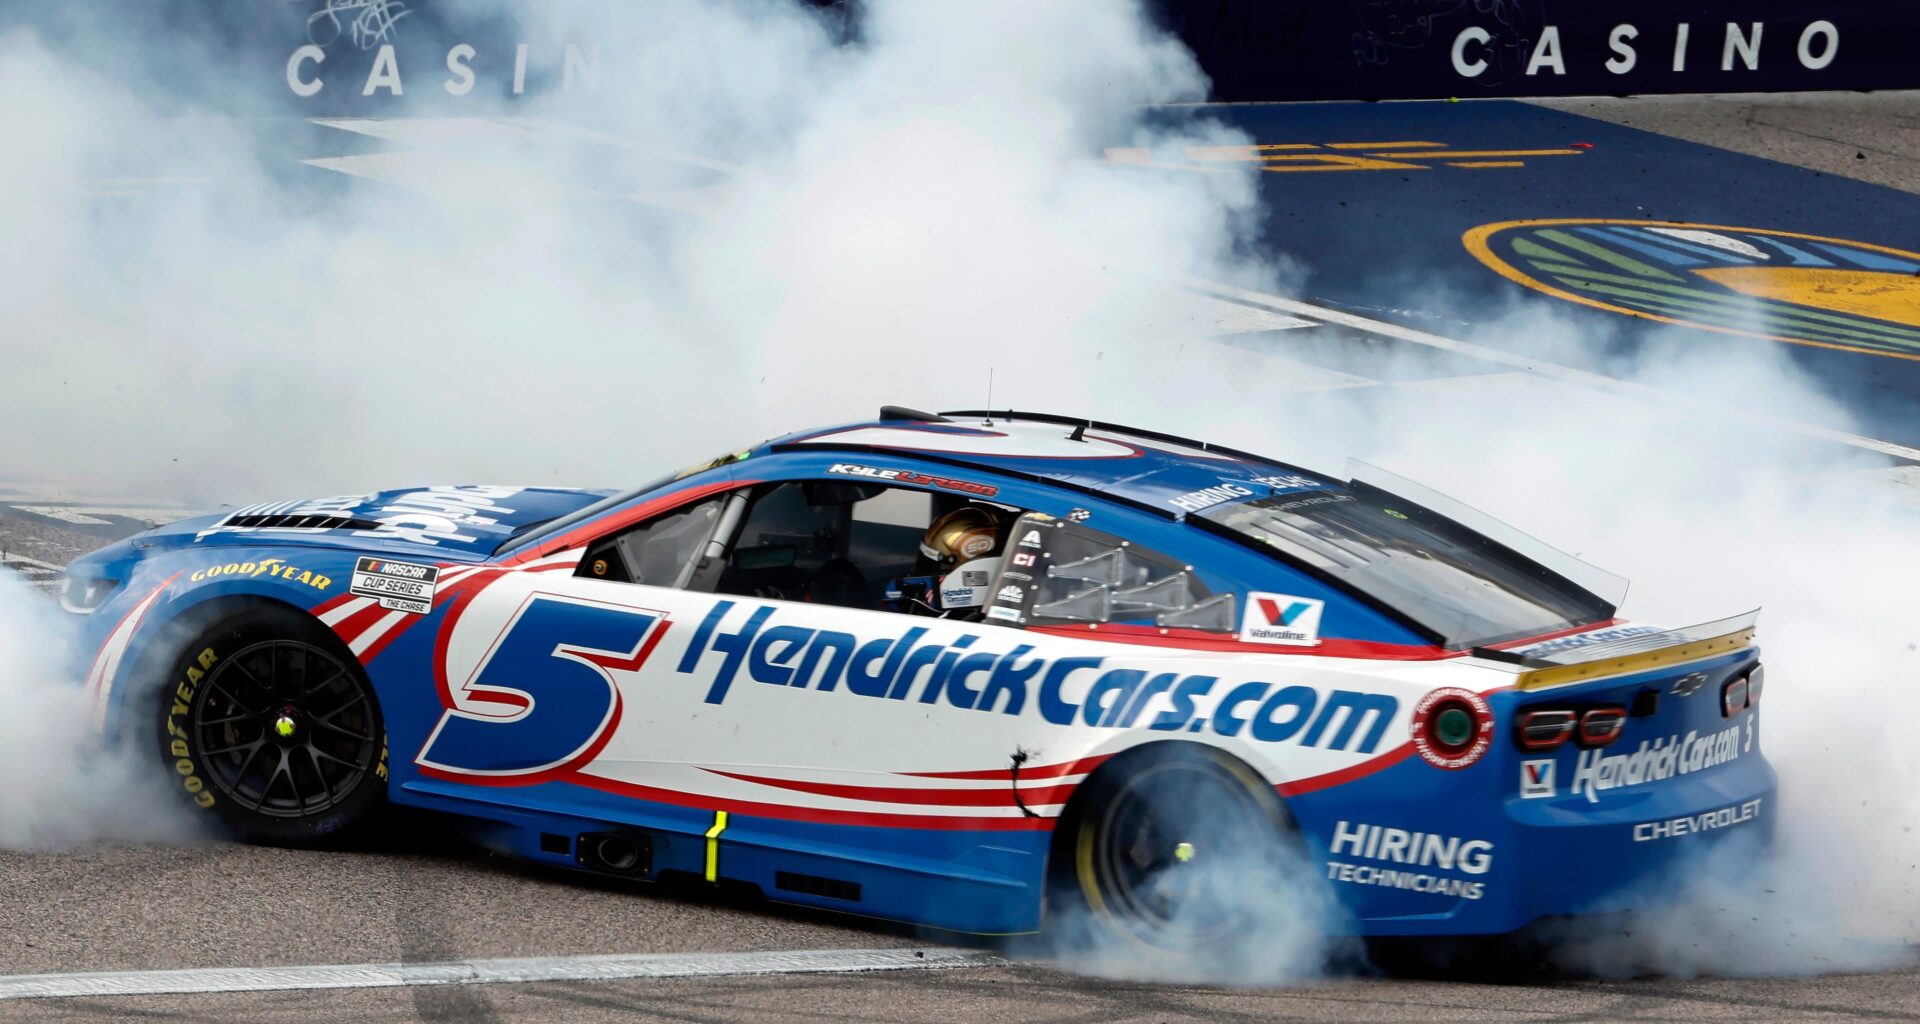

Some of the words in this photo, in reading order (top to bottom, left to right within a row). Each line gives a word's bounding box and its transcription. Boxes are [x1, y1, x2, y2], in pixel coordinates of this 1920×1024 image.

[286, 42, 681, 97] CASINO
[1451, 20, 1839, 78] CASINO
[1168, 483, 1253, 512] HIRING
[190, 558, 332, 590] GOODYEAR
[363, 577, 386, 589] CUP
[385, 580, 423, 595] SERIES
[381, 563, 427, 579] NASCAR
[386, 599, 400, 608] THE
[401, 601, 426, 612] CHASE
[1249, 628, 1310, 640] Valvoline
[413, 590, 674, 788] 5
[677, 600, 1400, 754] HendrickCars.com
[167, 647, 219, 809] GOODYEAR
[1571, 725, 1740, 803] HendrickCars.com
[1745, 713, 1754, 753] 5
[1633, 798, 1762, 842] CHEVROLET
[1330, 820, 1494, 874] HIRING
[1327, 862, 1483, 900] TECHNICIANS
